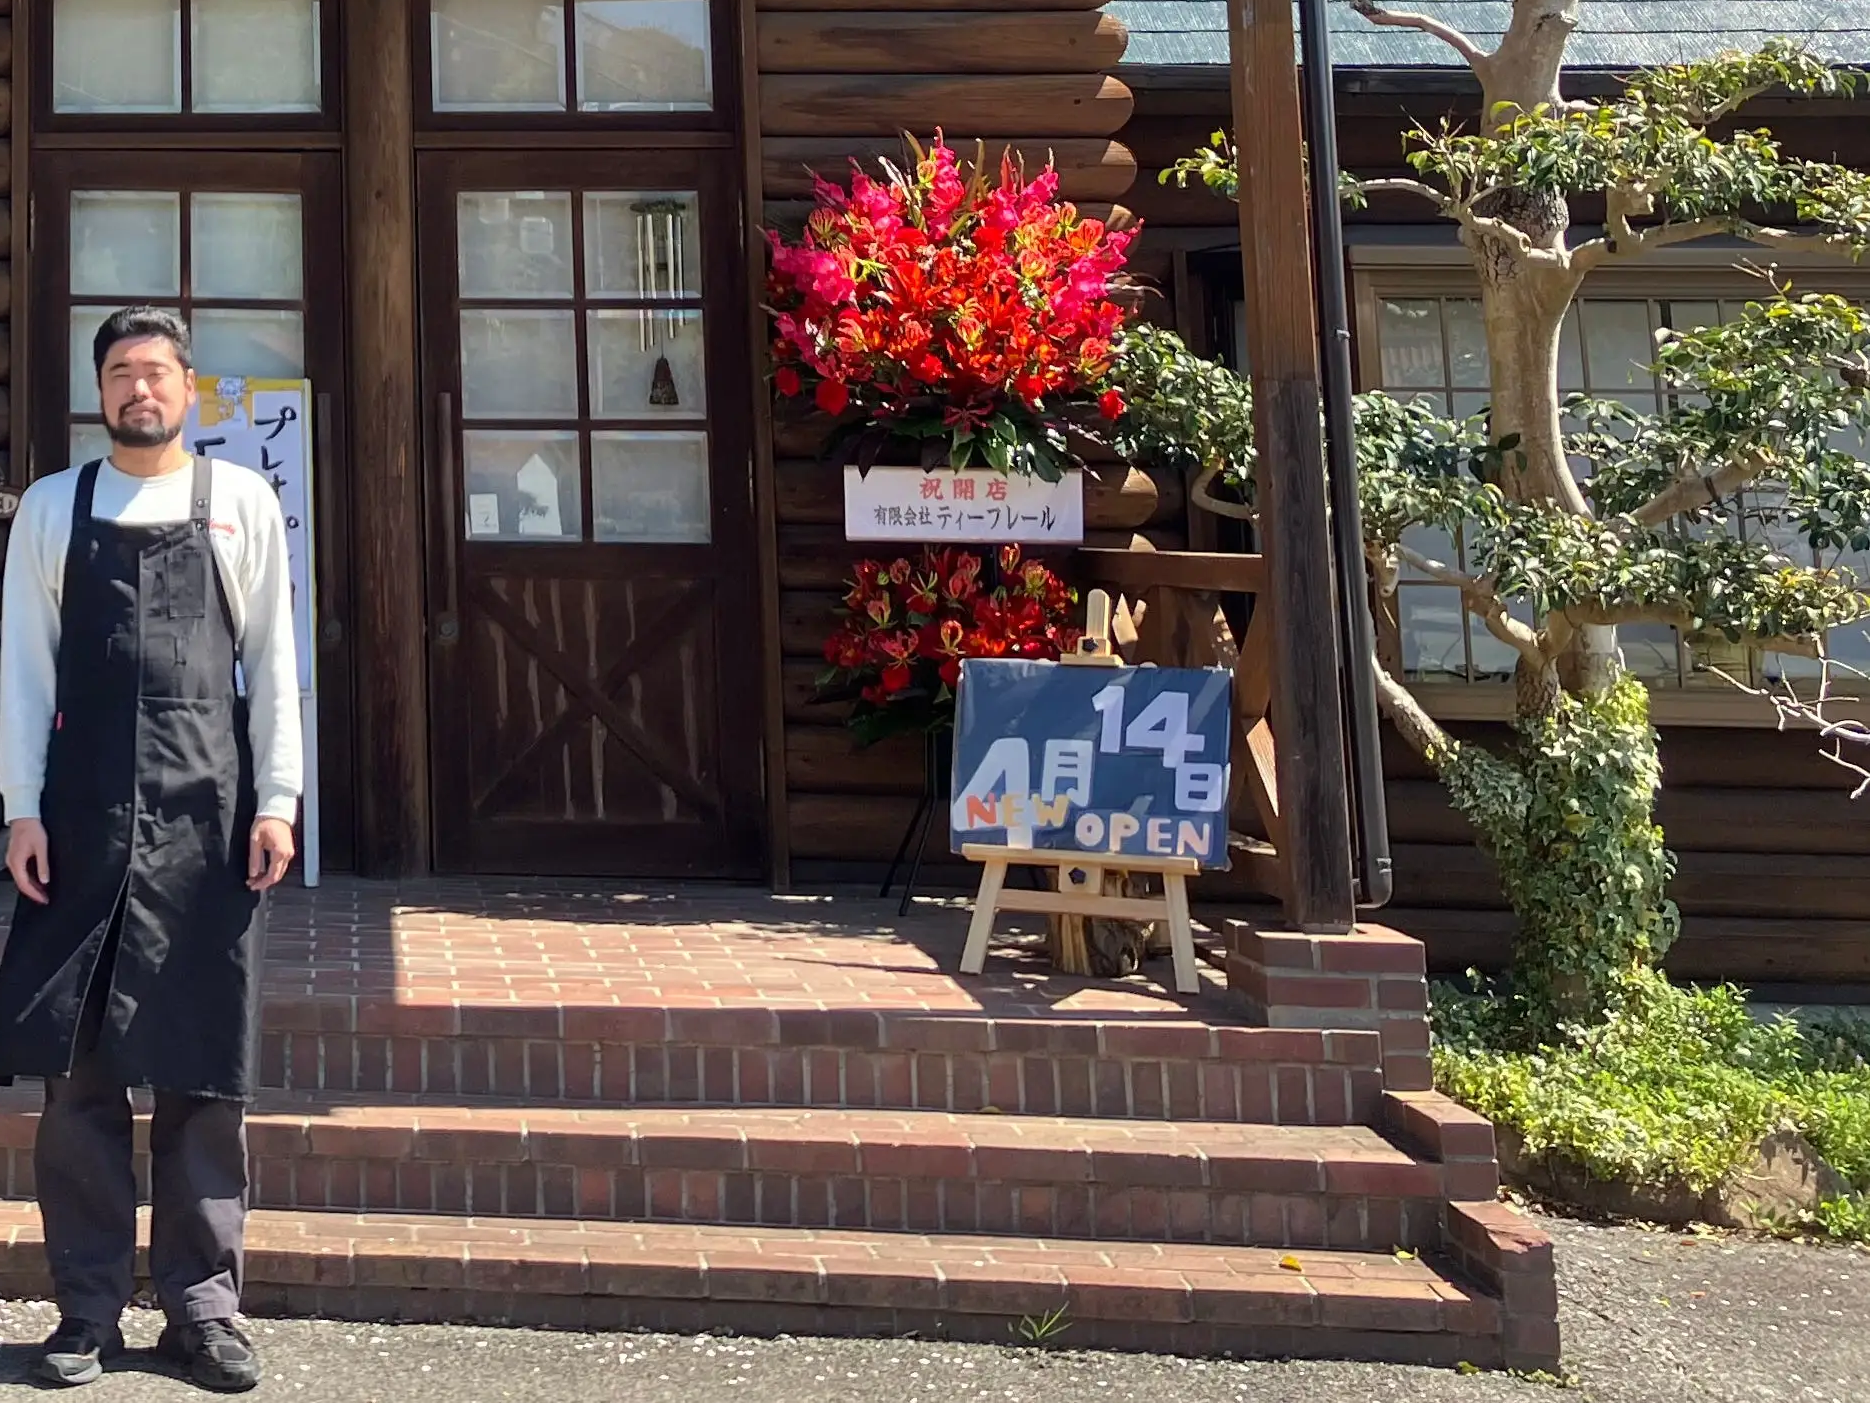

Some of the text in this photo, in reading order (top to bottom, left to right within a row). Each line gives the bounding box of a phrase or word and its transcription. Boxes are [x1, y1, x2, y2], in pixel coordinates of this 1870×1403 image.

[919, 477, 1008, 501] 祝開店
[966, 792, 1071, 831] NEW
[1074, 811, 1211, 856] OPEN
